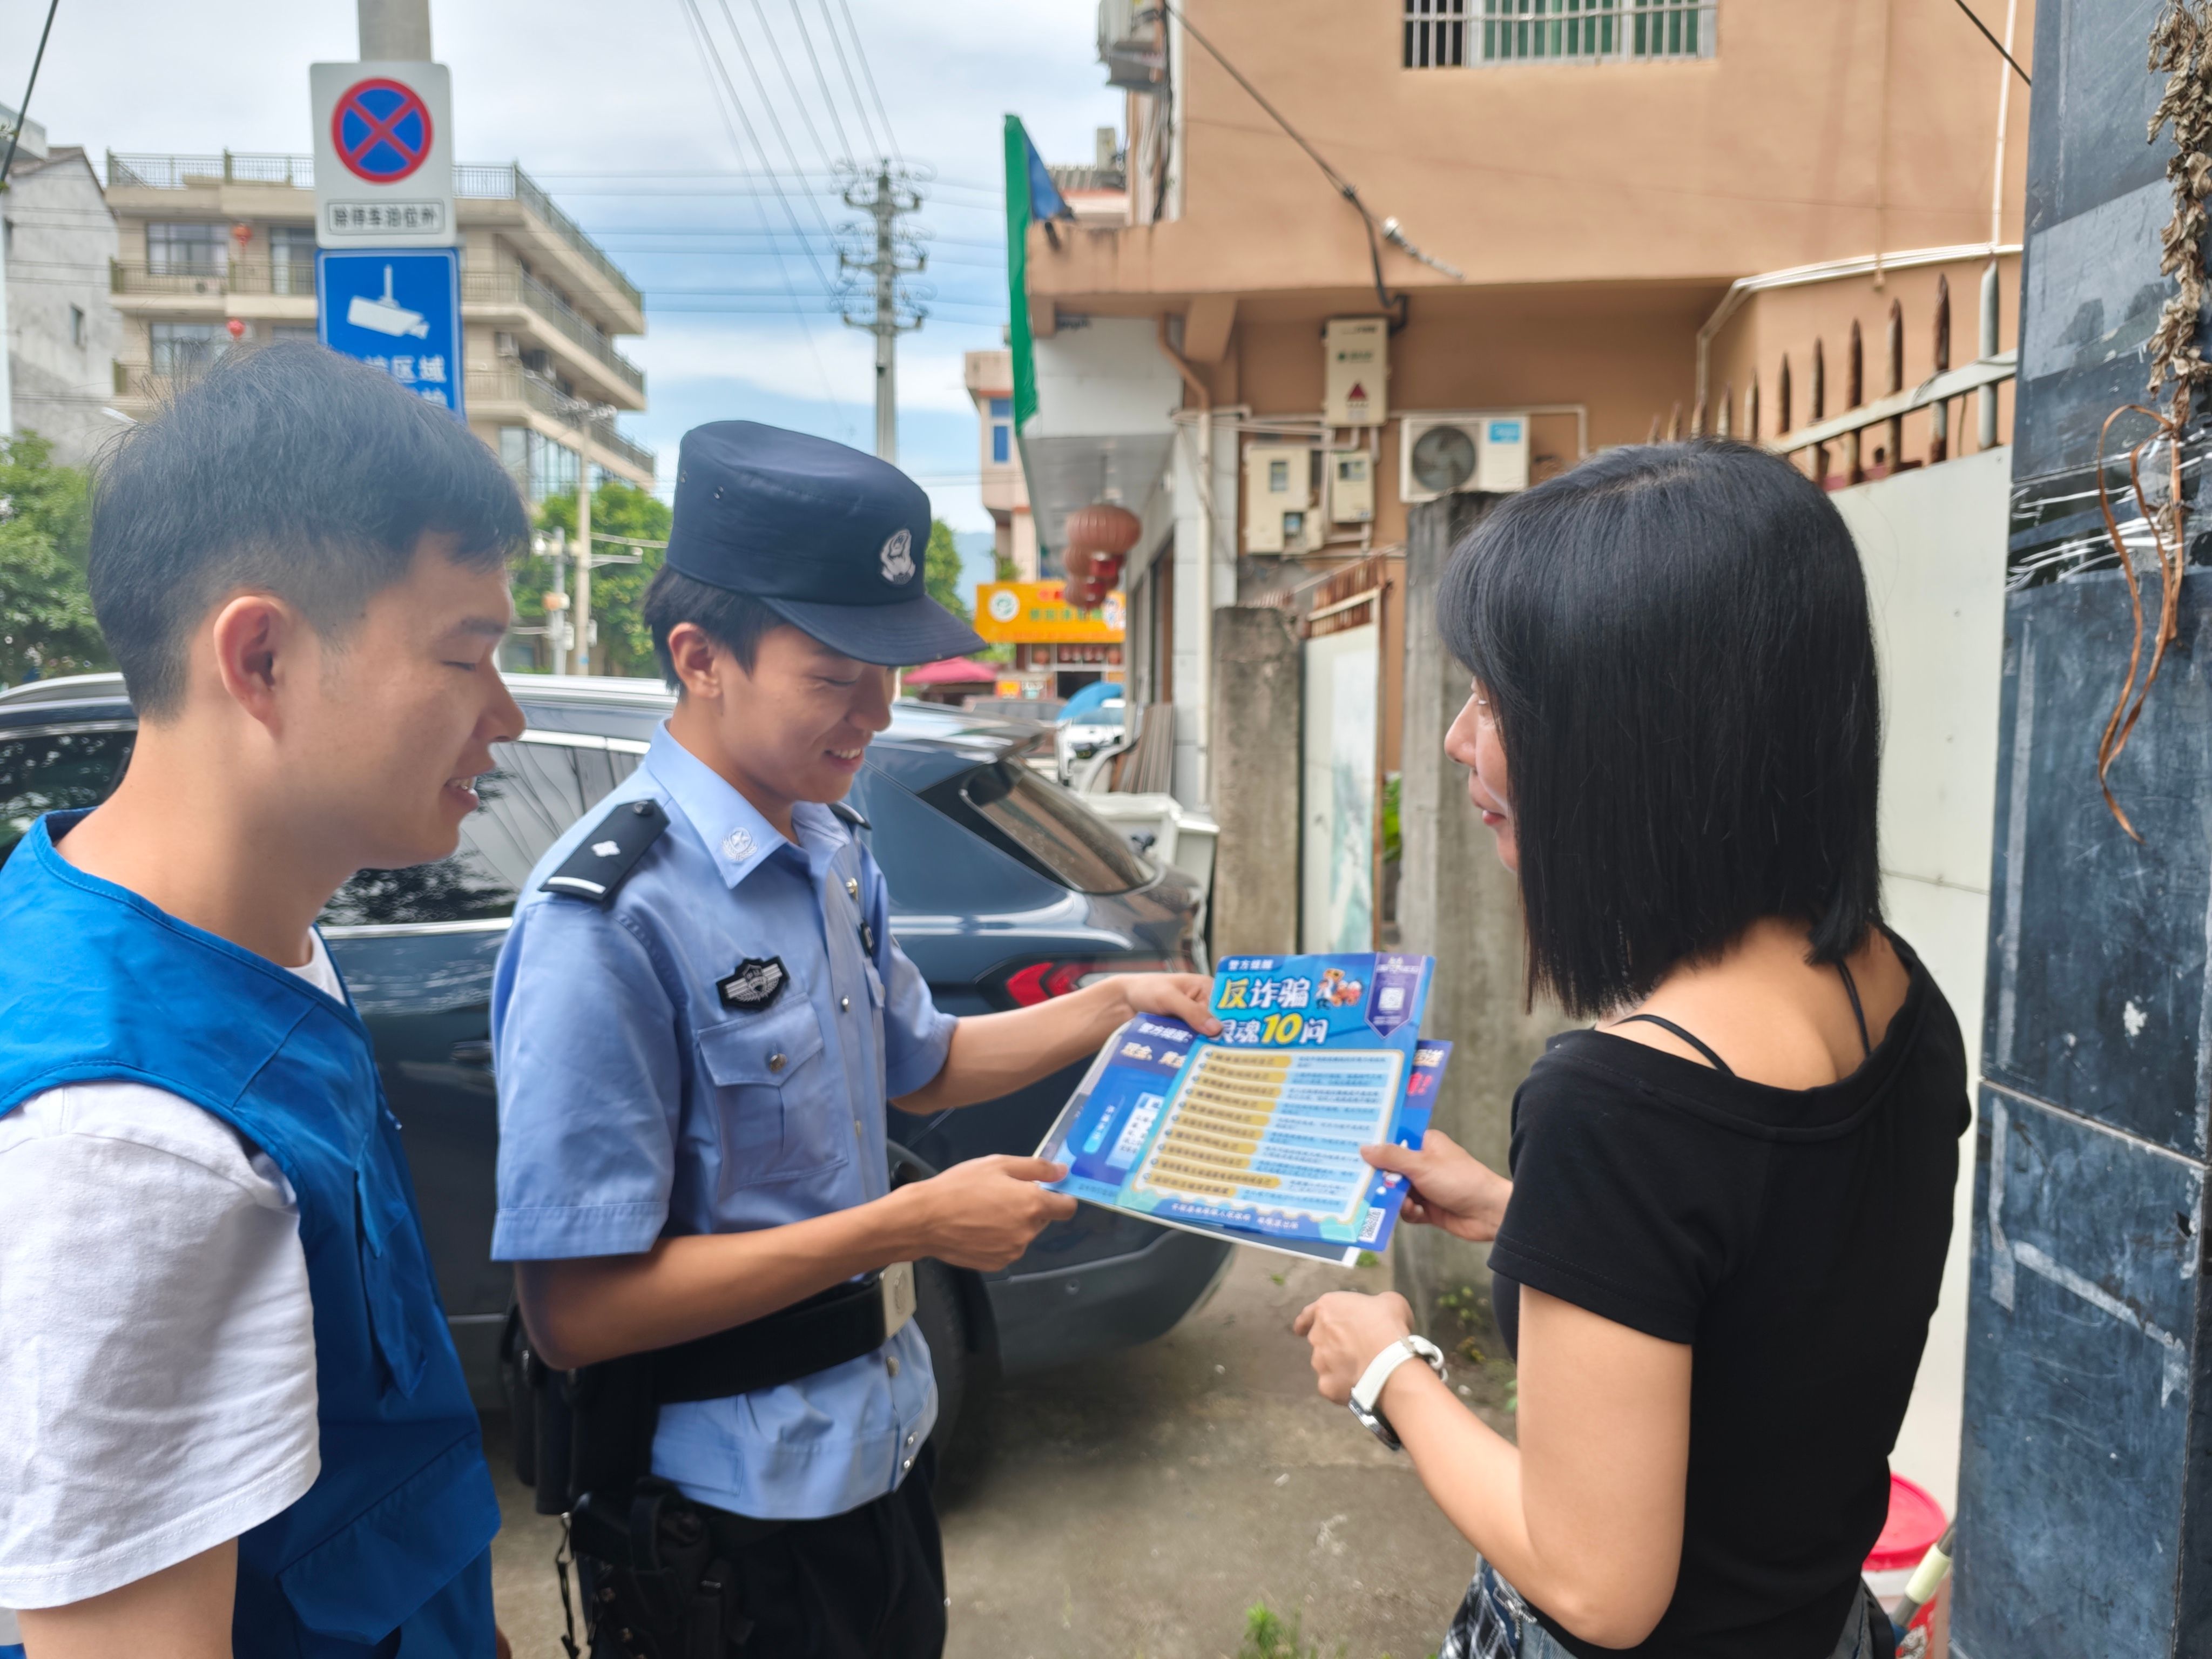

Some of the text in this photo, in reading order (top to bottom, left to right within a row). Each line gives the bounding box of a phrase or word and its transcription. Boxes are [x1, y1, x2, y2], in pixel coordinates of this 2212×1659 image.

[1228, 959, 1273, 972] 警方提醒
[1217, 976, 1311, 1009] 反诈骗
